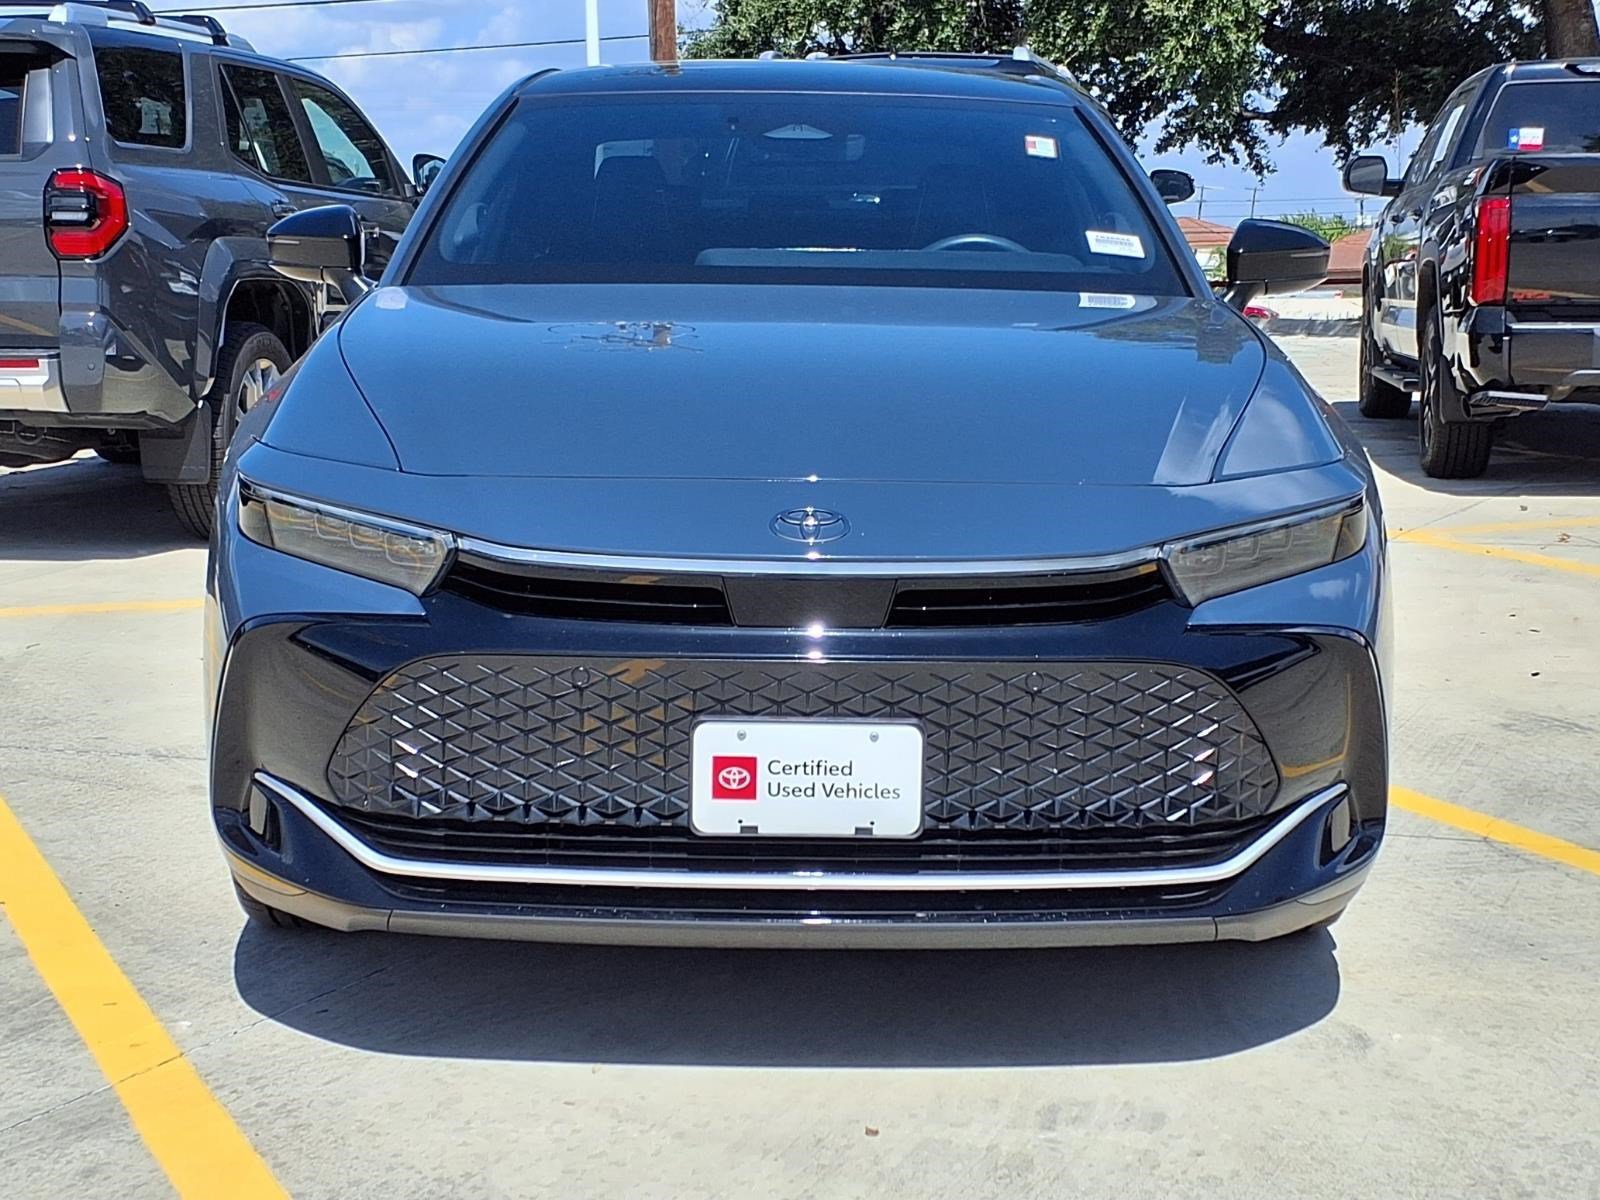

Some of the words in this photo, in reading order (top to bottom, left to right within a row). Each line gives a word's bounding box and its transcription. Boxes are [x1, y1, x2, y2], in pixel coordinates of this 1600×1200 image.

[767, 759, 853, 777] Certified
[767, 781, 816, 798] Used
[821, 782, 901, 800] Vehicles
